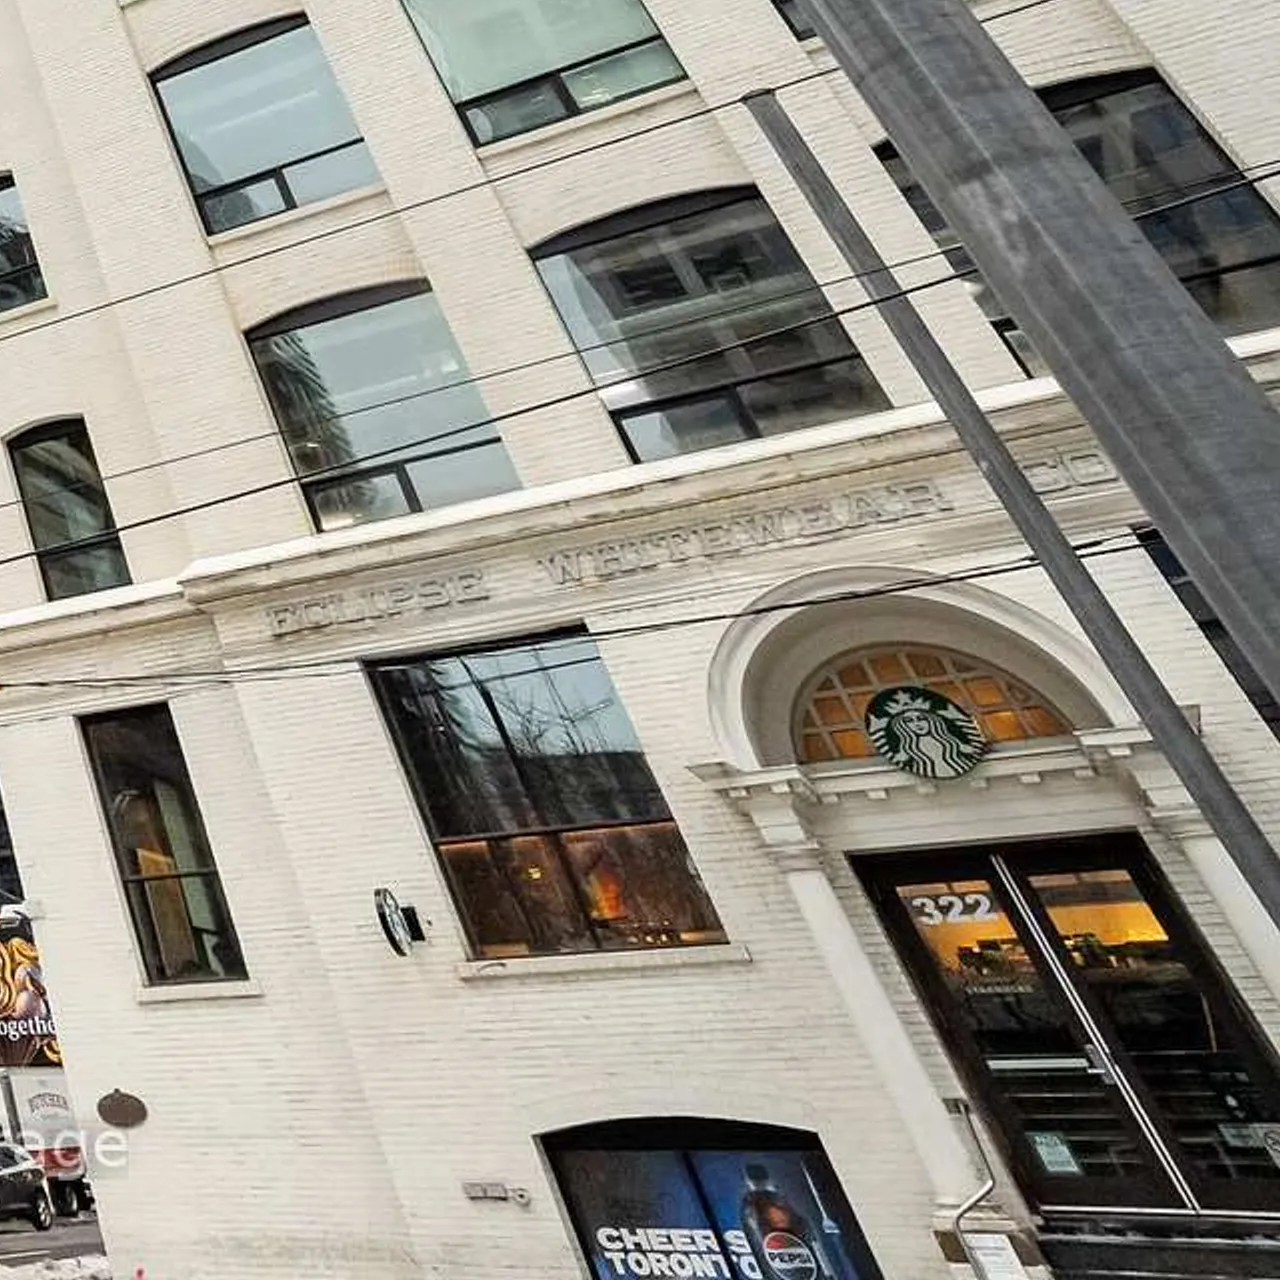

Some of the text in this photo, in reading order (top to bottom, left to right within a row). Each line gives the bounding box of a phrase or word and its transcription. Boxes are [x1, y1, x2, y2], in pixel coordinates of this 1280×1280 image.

[267, 568, 492, 637] ECLIPSE
[537, 478, 953, 586] WHITEWEAR
[911, 893, 999, 926] 322
[595, 1226, 752, 1253] CHEERS
[603, 1251, 765, 1280] TORONTO
[767, 1251, 812, 1267] PEPSI
